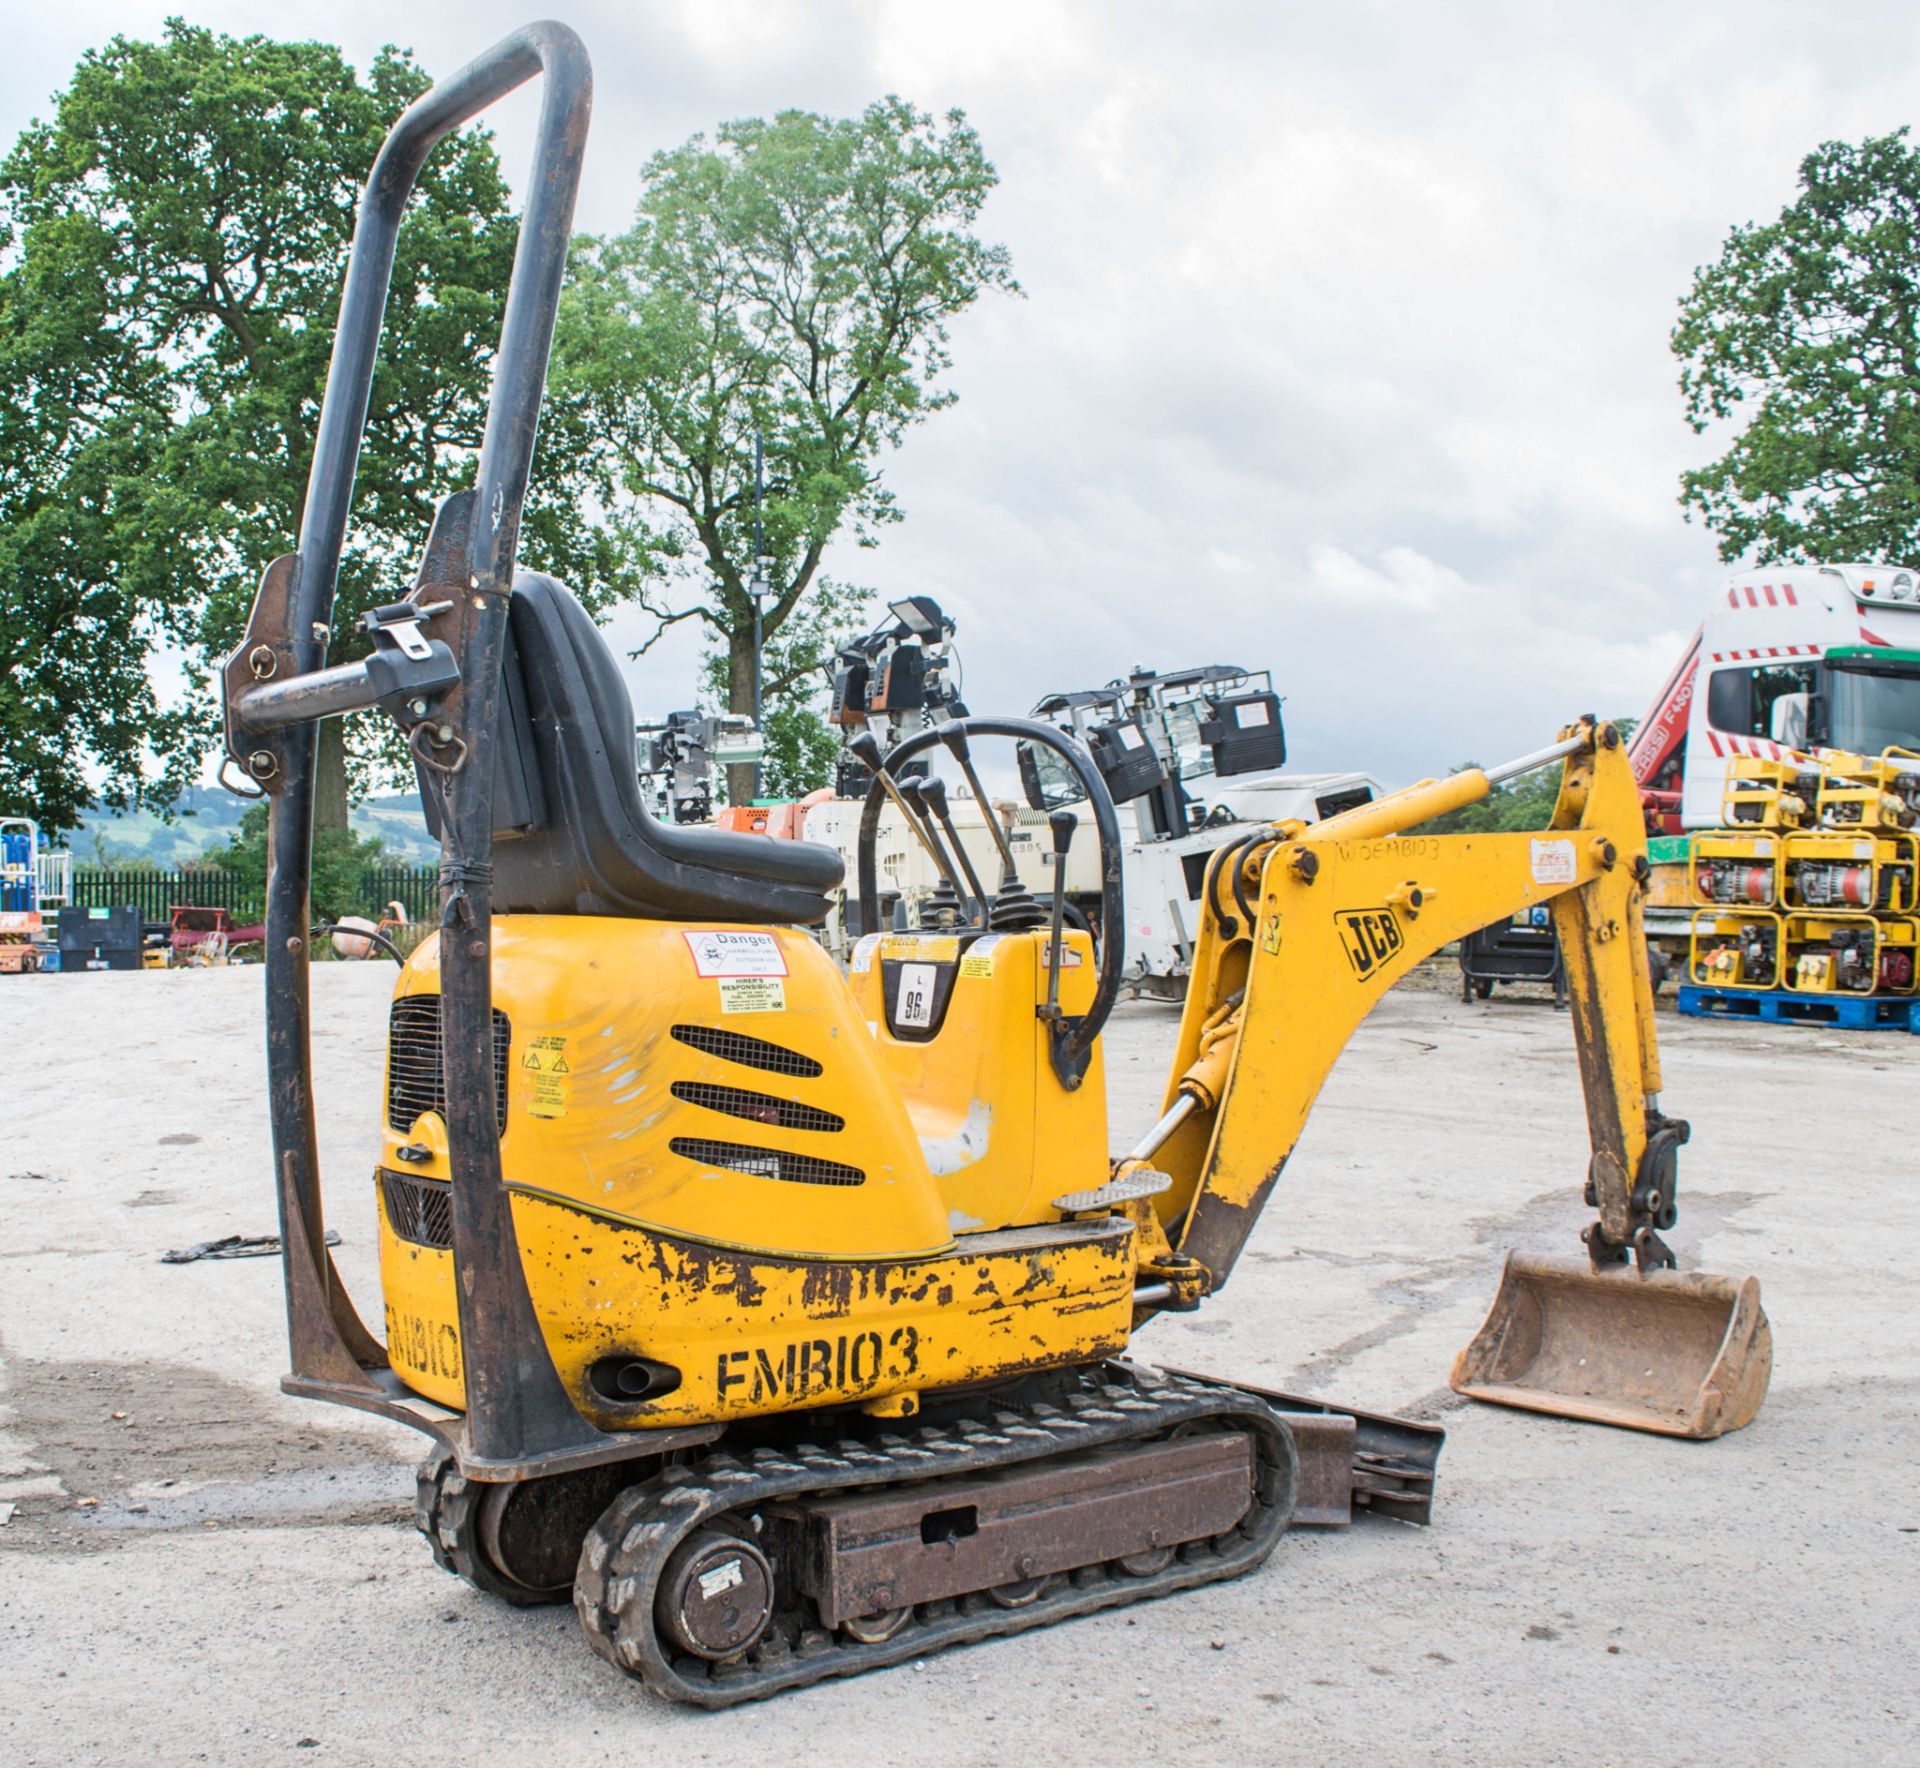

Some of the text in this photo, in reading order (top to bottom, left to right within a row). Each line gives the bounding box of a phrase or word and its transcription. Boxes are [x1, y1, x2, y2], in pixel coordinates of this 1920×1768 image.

[716, 933, 772, 947] Danger
[1347, 914, 1399, 973] JCB
[722, 983, 779, 991] RESPONSIBILITY
[905, 991, 923, 1020] 96
[717, 1326, 918, 1410] EMB103
